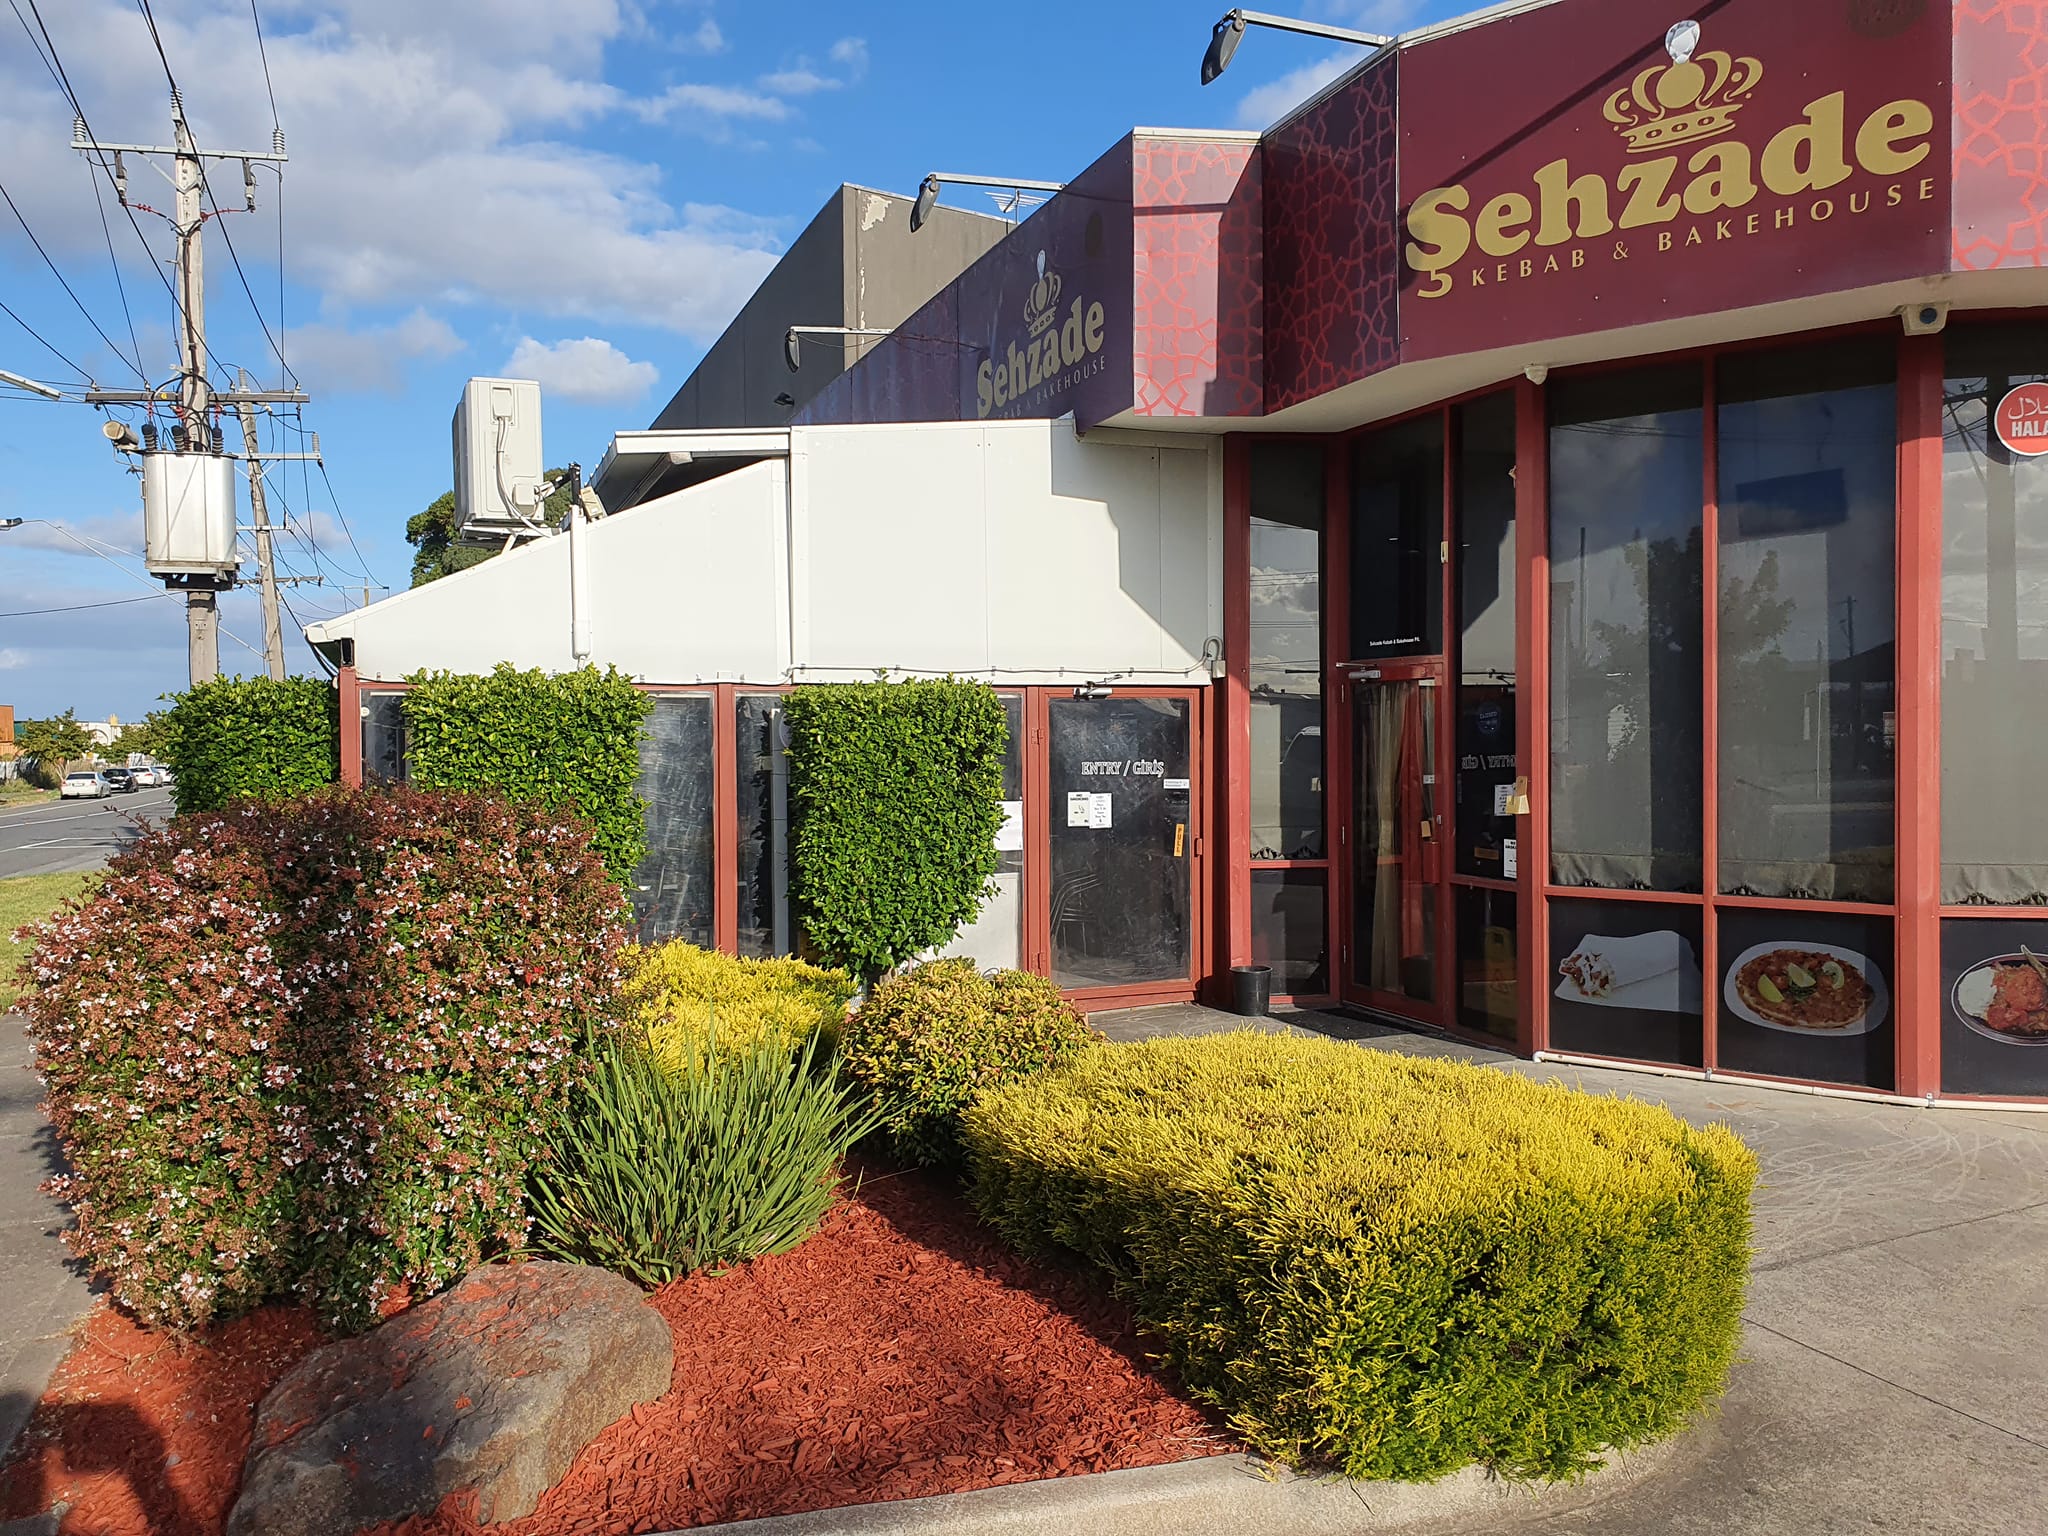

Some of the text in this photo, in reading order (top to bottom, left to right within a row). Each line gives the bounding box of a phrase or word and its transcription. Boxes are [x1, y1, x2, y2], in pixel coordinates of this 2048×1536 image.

[1405, 91, 1934, 298] Şehzade
[1472, 177, 1935, 287] KEBAB & BAKEHOUSE
[1036, 355, 1105, 405] BAKEHOUSE
[2011, 420, 2048, 437] HALA
[1081, 761, 1122, 775] ENTRY
